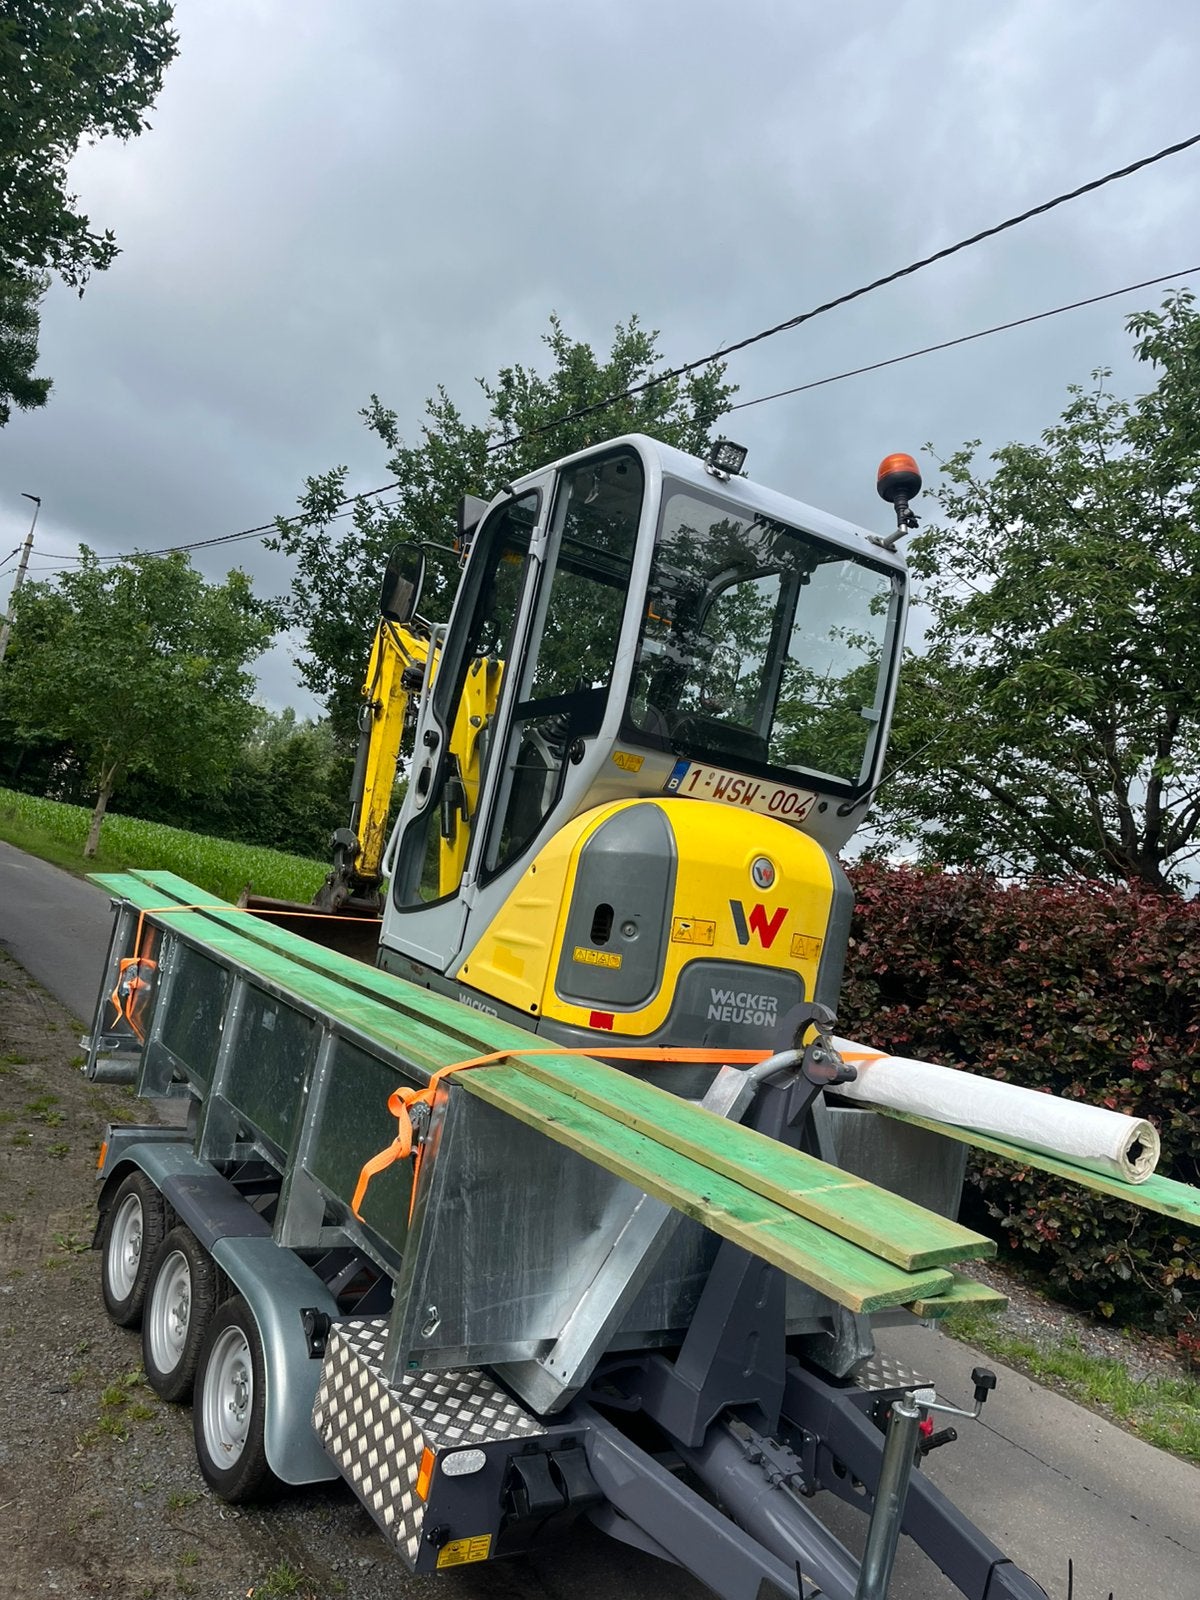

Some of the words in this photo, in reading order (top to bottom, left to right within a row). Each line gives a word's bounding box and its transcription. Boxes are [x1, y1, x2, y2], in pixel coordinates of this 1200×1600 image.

[668, 777, 679, 789] B
[688, 769, 813, 817] 1-WSW-004
[710, 988, 778, 1012] WACKER
[707, 1004, 777, 1027] NEUSON
